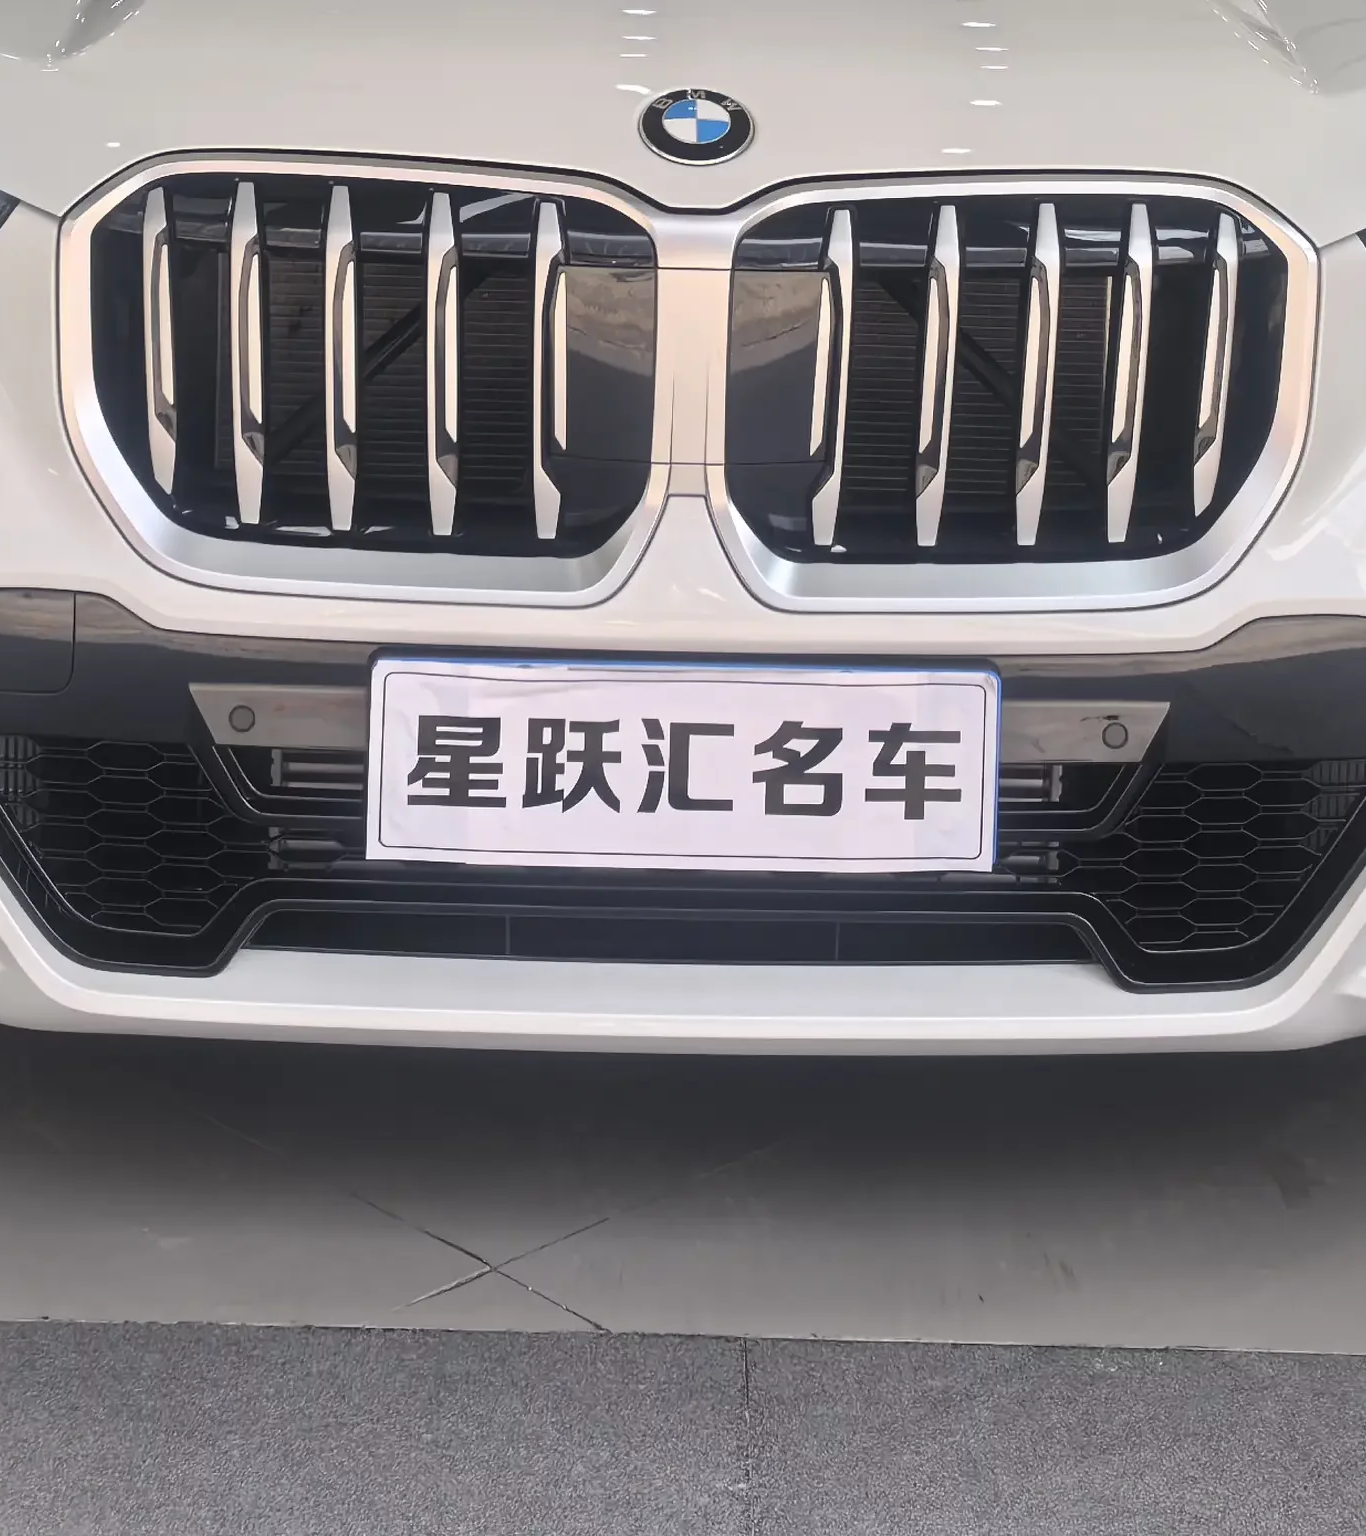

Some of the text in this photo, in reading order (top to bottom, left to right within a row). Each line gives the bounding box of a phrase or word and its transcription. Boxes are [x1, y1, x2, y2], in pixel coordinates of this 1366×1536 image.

[652, 89, 742, 111] BMW
[407, 715, 962, 820] 星跃汇名车
